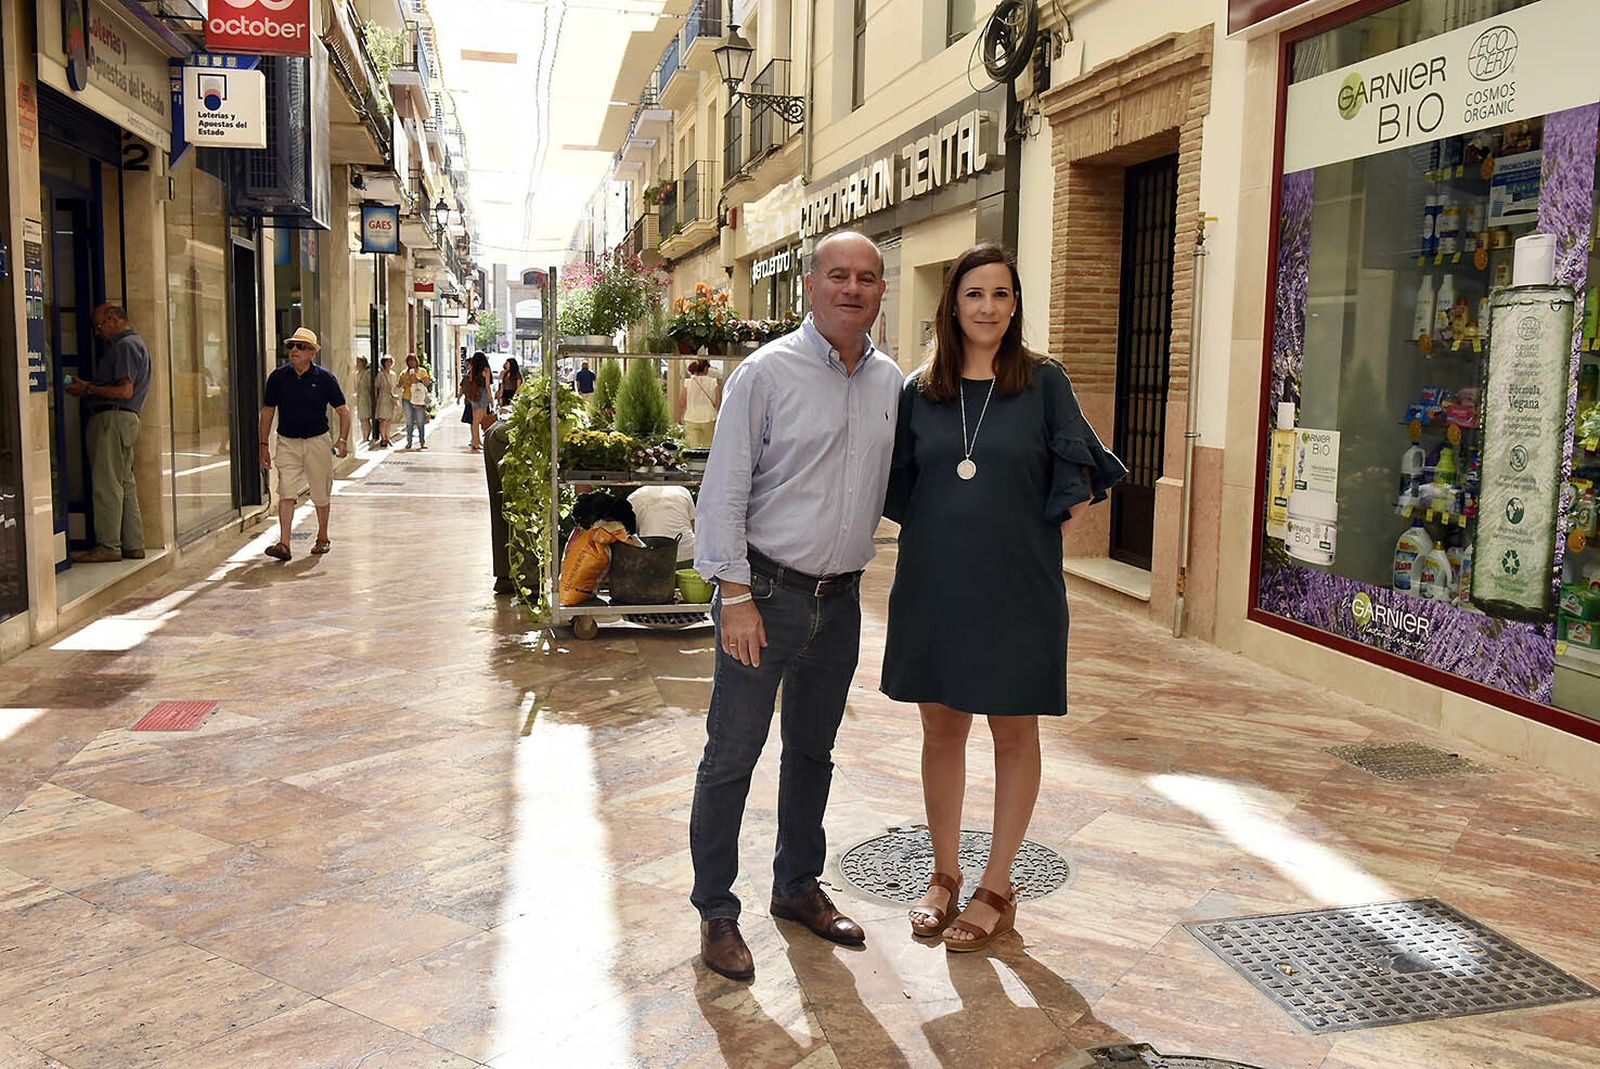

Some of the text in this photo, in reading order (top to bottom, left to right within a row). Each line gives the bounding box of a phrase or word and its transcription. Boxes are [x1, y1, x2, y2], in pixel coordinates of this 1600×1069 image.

[209, 15, 306, 38] october
[1477, 29, 1509, 57] ECO
[1475, 49, 1511, 77] CERT
[1465, 81, 1516, 107] COSMOS
[198, 111, 229, 119] Loterías
[1378, 92, 1444, 144] BIO
[1464, 98, 1515, 123] ORGANIC
[199, 120, 233, 128] Apuestas
[122, 144, 150, 171] 2
[901, 109, 988, 202] DENTAL
[368, 220, 392, 230] GAES
[1509, 395, 1540, 413] Vegana
[1312, 443, 1330, 456] BIO
